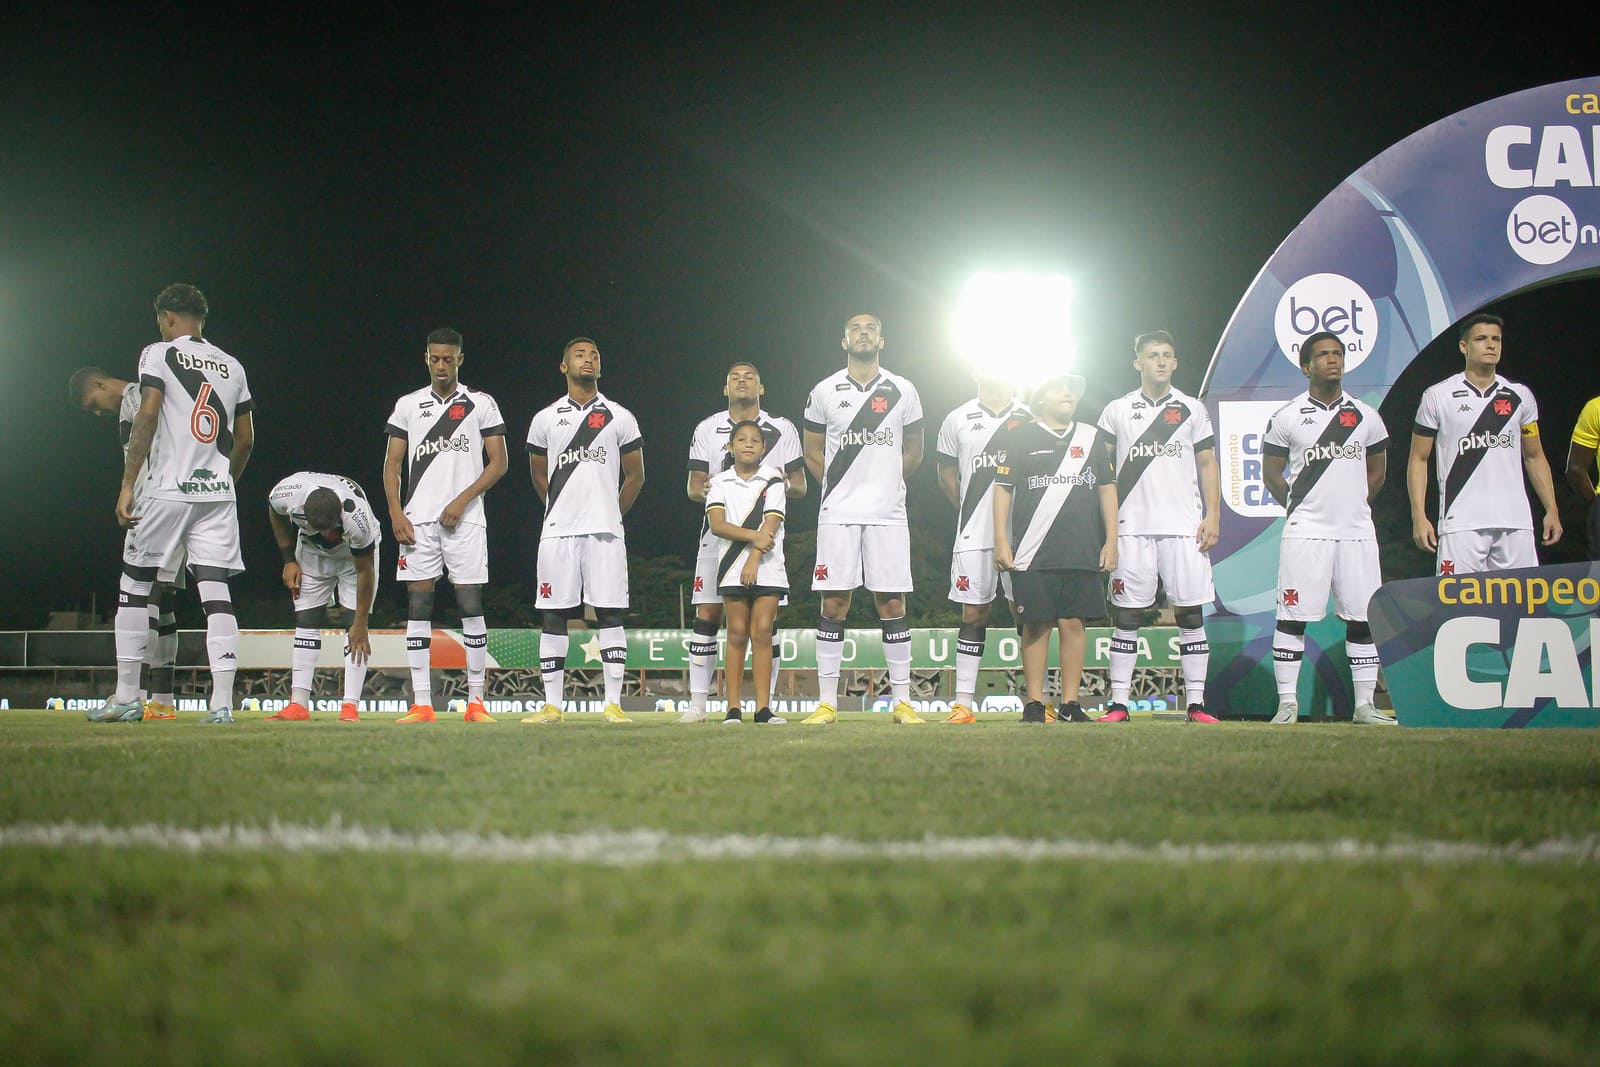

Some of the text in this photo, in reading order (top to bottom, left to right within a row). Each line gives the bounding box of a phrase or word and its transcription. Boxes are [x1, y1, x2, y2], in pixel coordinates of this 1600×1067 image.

[1485, 124, 1600, 189] CA
[1513, 213, 1572, 245] bet
[1290, 296, 1363, 336] bet
[191, 382, 220, 444] 6
[415, 434, 470, 462] pixbet
[839, 427, 893, 451] pixbet
[1129, 440, 1184, 462] pixbet
[1304, 441, 1362, 467] pixbet
[1458, 429, 1514, 456] pixbet
[558, 446, 607, 470] pixbet
[1438, 576, 1600, 614] campeo
[1433, 616, 1600, 710] CA
